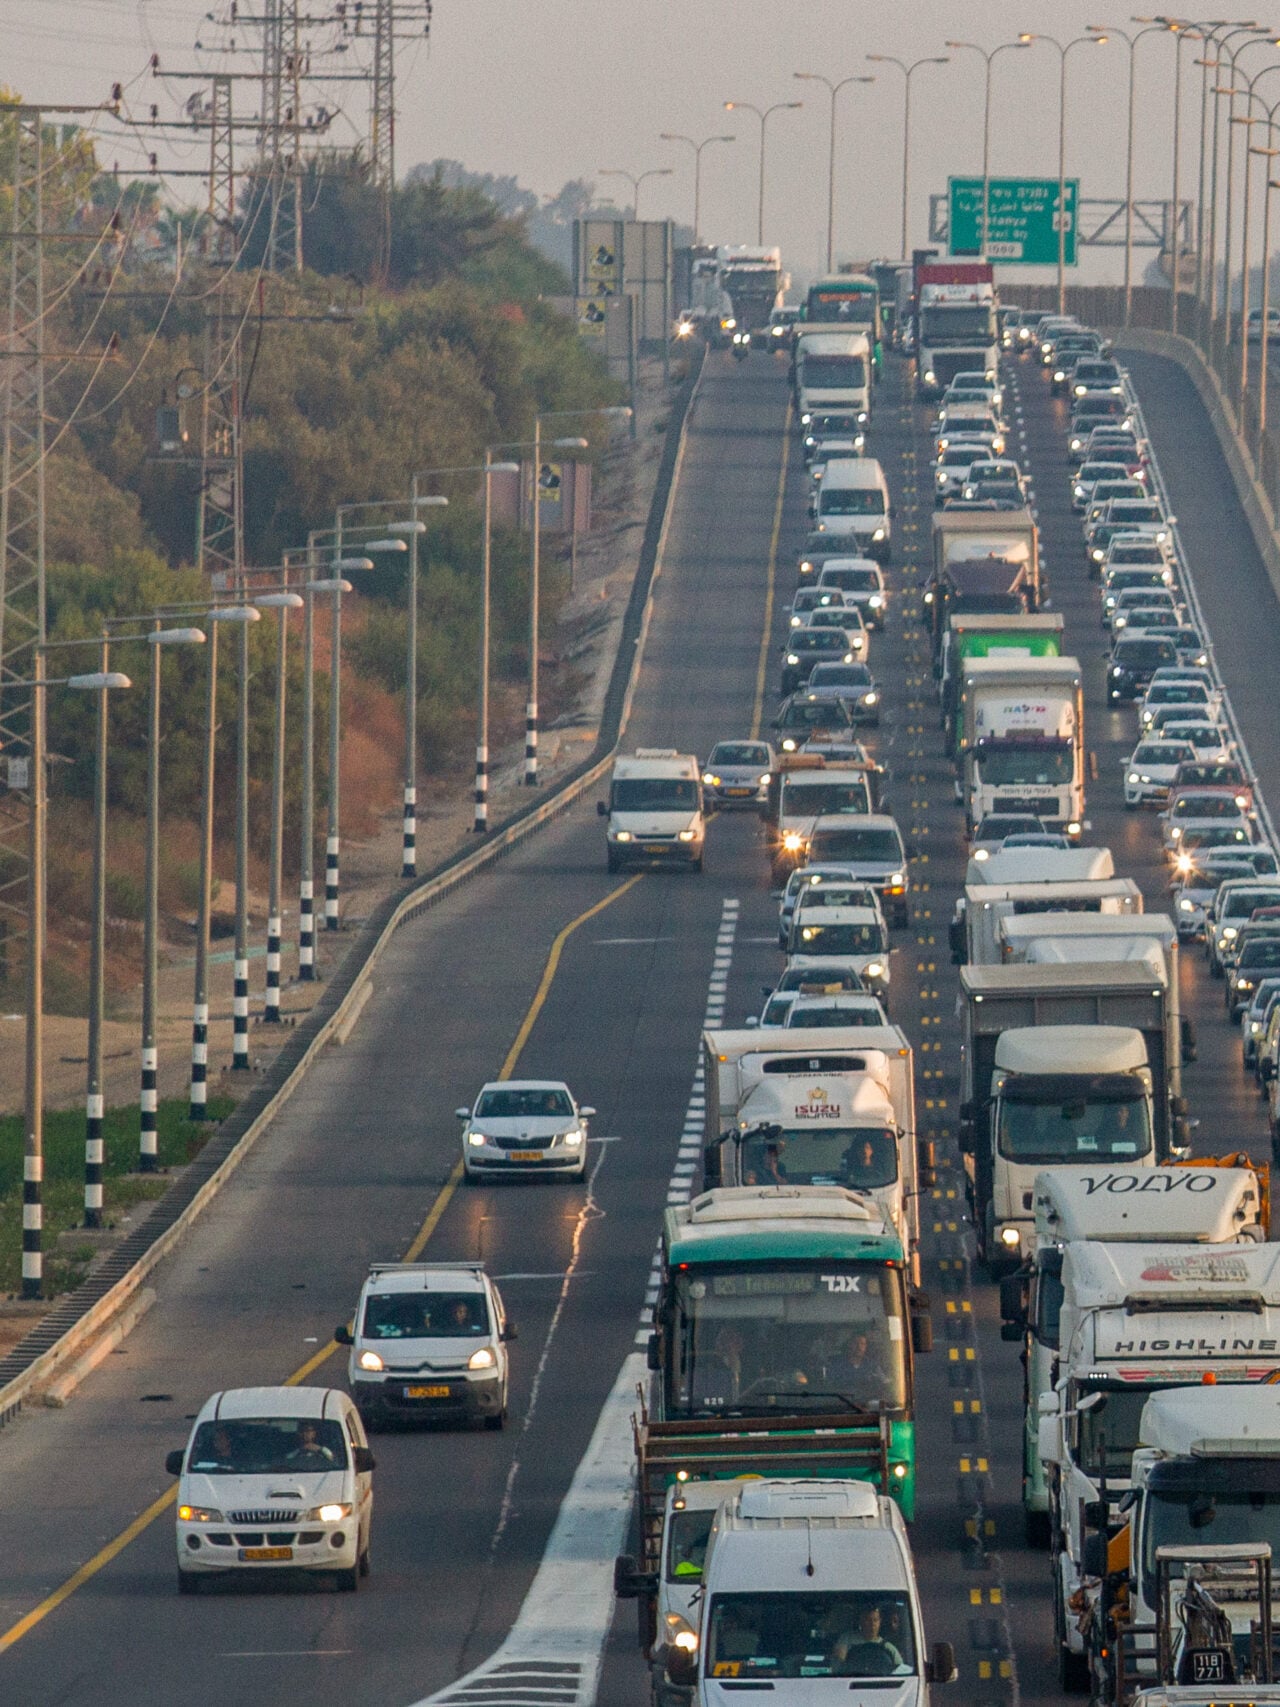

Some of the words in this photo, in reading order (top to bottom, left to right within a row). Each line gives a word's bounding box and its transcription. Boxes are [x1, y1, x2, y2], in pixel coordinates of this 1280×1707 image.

[795, 1105, 840, 1113] ISUZU
[1080, 1173, 1217, 1195] VOLVO
[820, 1275, 861, 1293] אגד
[1115, 1339, 1278, 1352] HIGHLINE
[1197, 1667, 1221, 1679] 771
